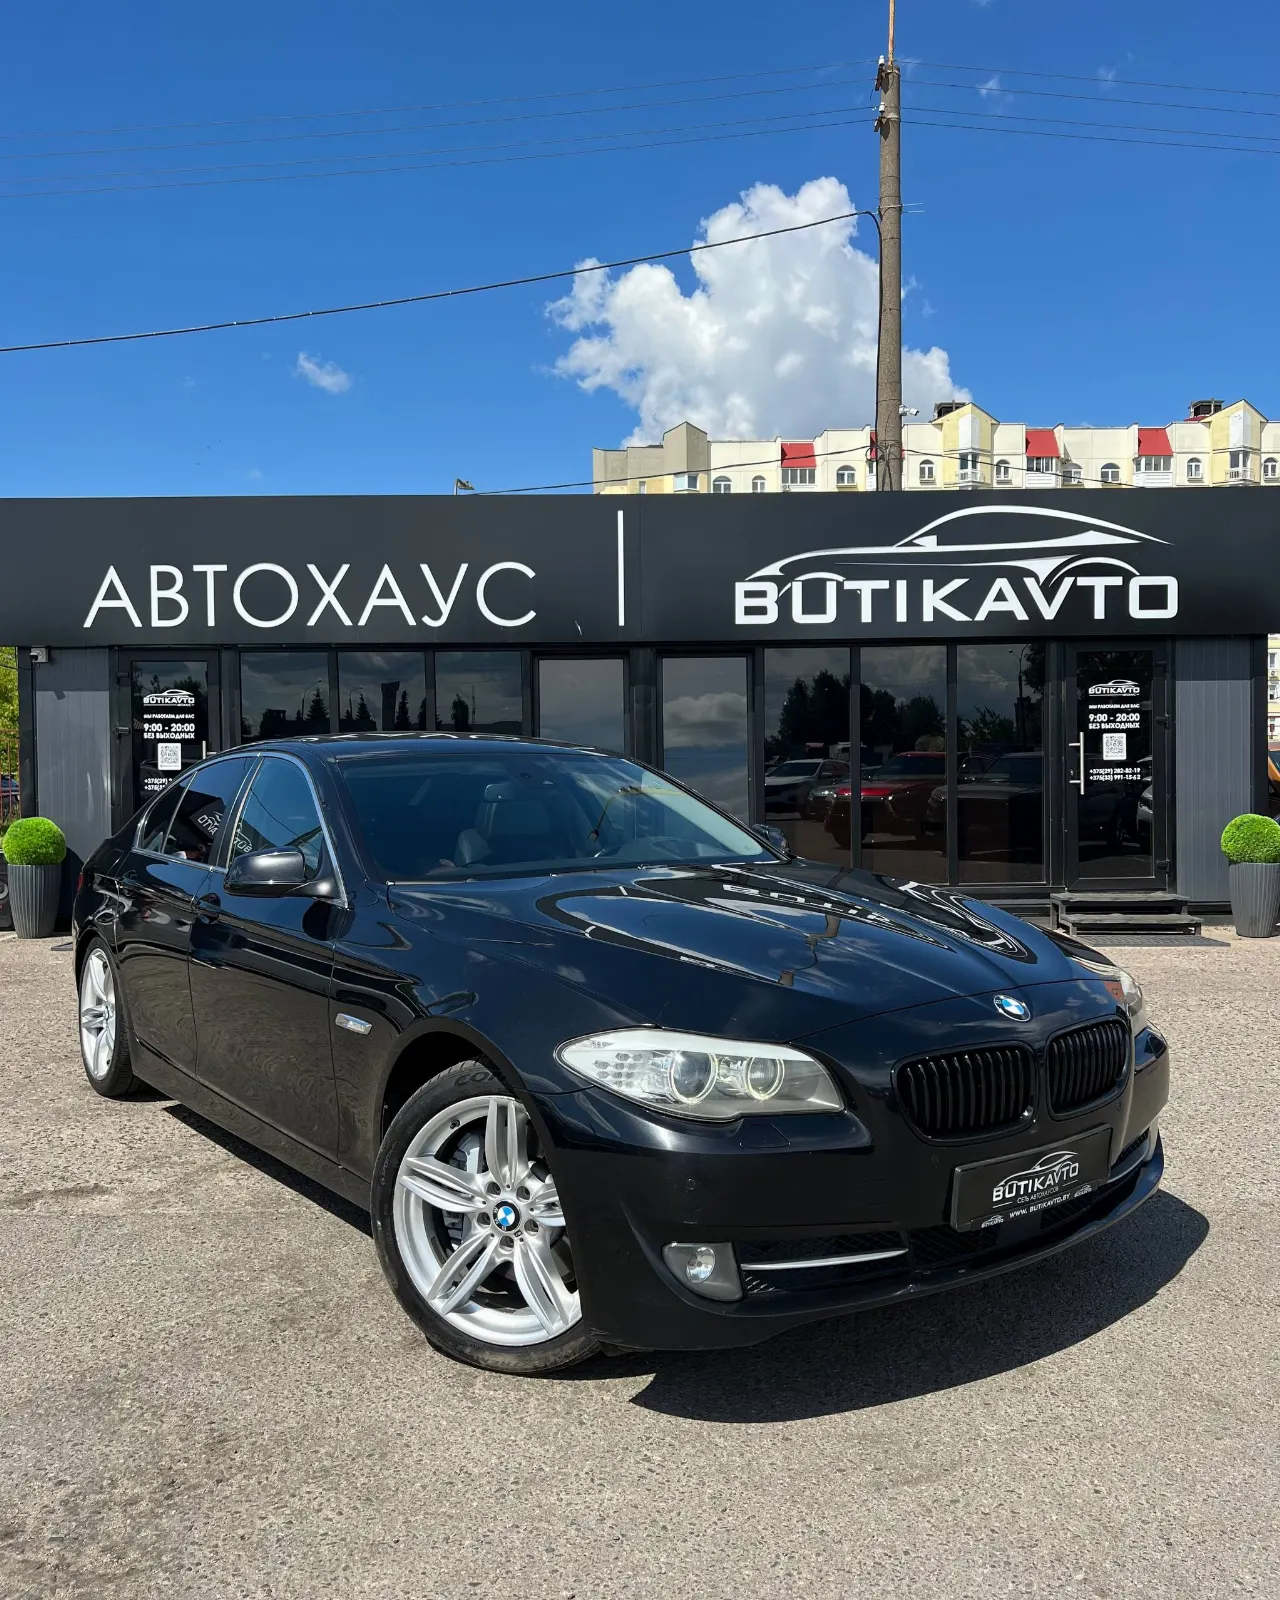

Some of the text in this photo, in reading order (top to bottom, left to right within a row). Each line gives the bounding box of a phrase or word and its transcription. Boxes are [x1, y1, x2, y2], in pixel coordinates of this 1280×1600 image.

[83, 561, 537, 628] АВТОХАУС
[735, 575, 1178, 625] BUTIKAVTO
[1088, 713, 1108, 722] 9:00
[1115, 712, 1140, 721] 20:00
[143, 723, 163, 731] 9:00
[170, 723, 195, 731] 20:00
[155, 732, 195, 740] ВЫХОДНЫХ
[992, 1162, 1080, 1202] BUTIKAVTO
[1016, 1195, 1030, 1204] СЕТЬ
